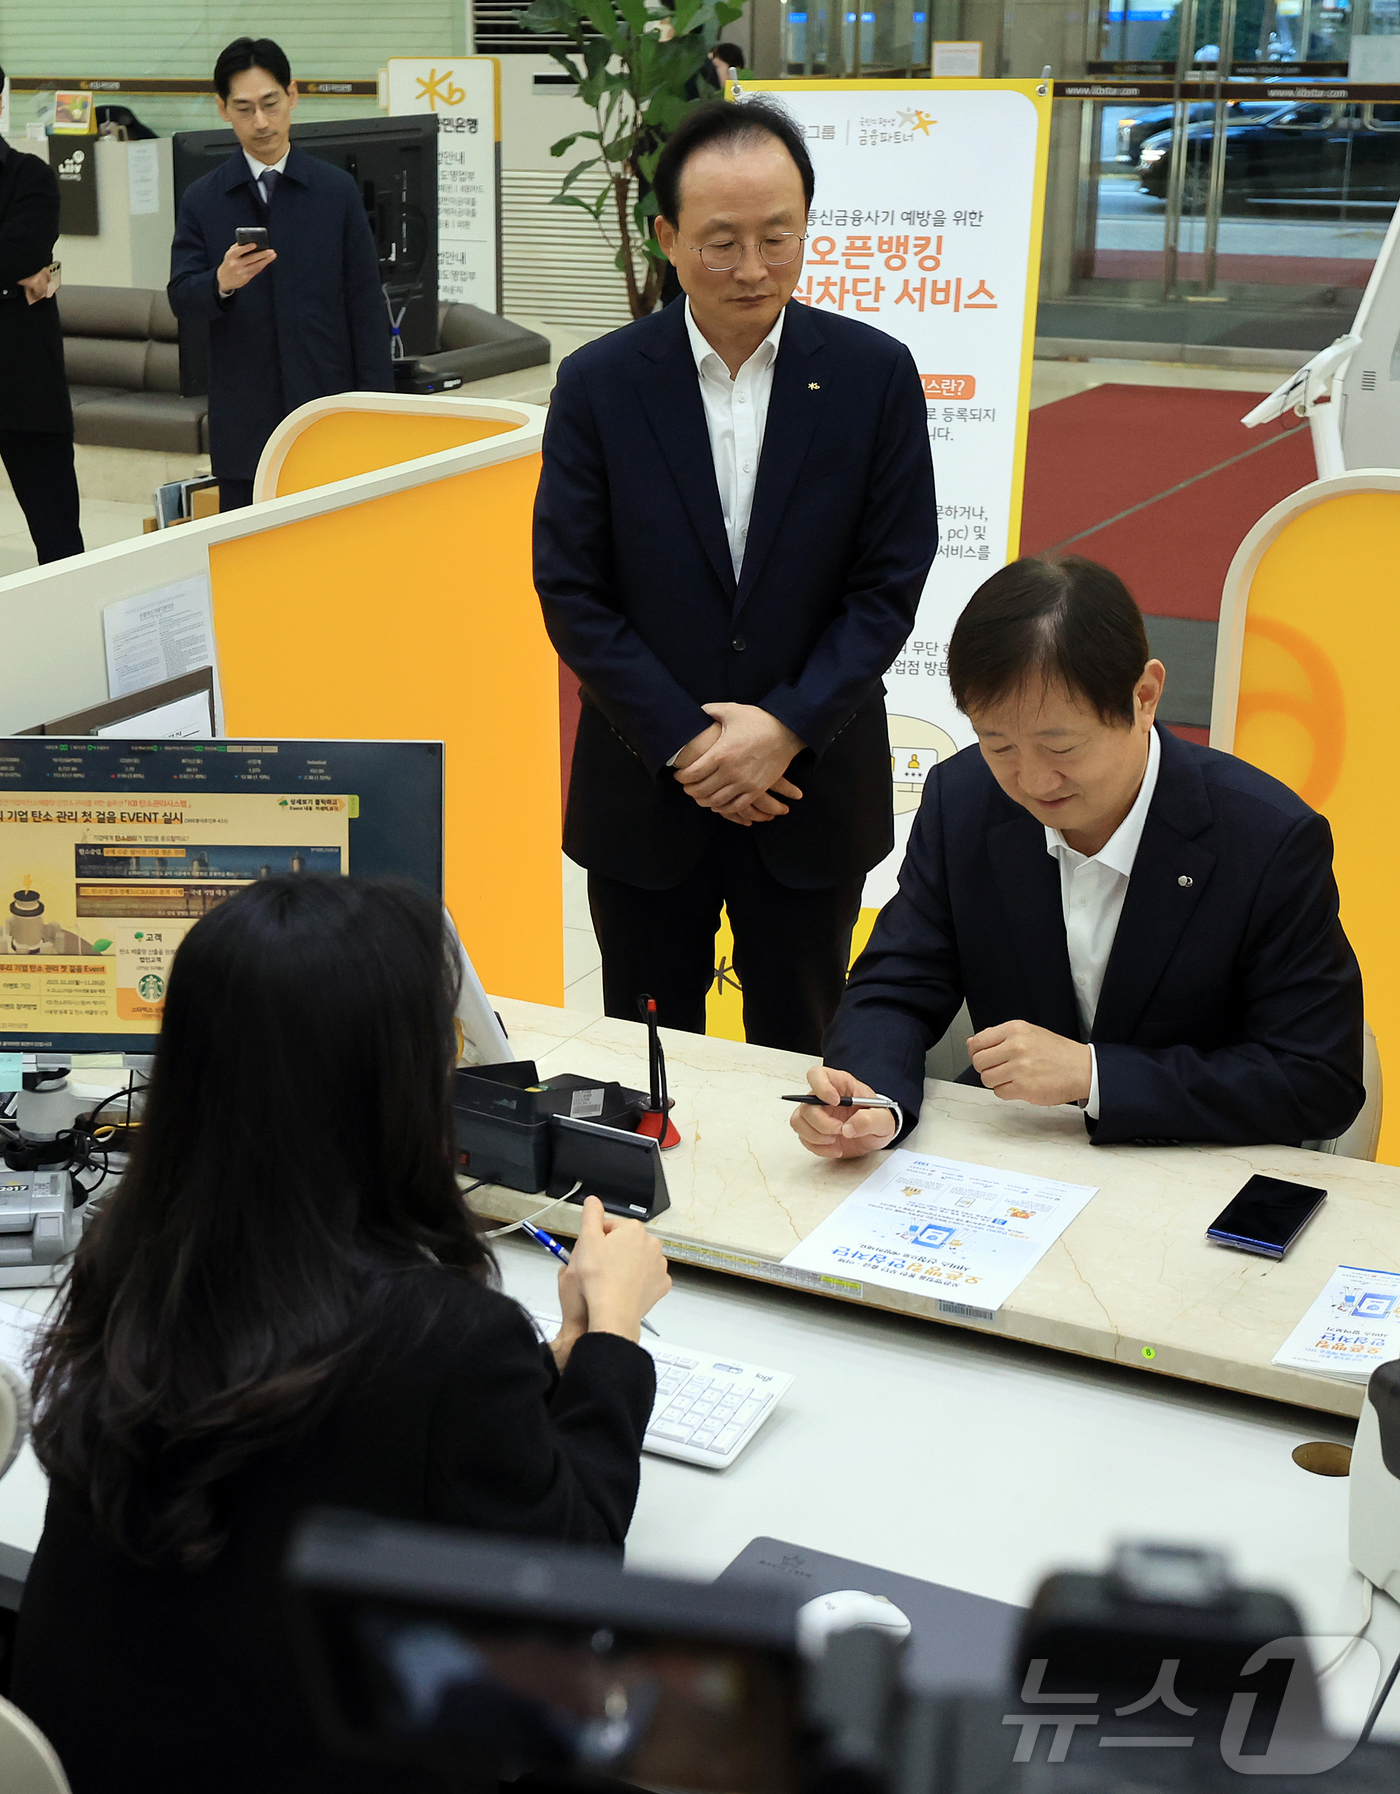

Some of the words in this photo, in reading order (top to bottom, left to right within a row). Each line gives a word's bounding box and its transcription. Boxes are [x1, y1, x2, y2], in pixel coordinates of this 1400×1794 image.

[859, 129, 914, 146] 금융파트너
[900, 210, 947, 227] 예방을
[952, 210, 984, 227] 위한
[806, 235, 943, 271] 오픈뱅킹
[894, 277, 998, 313] 서비스
[942, 408, 996, 422] 등록되지
[973, 525, 986, 541] 및
[937, 544, 991, 560] 서비스를
[912, 641, 939, 657] 무단
[7, 811, 28, 823] 기업
[31, 811, 53, 822] 탄소
[56, 811, 77, 822] 관리
[81, 811, 92, 823] 첫
[96, 811, 117, 824] 걸음
[120, 812, 159, 823] EVENT
[162, 812, 183, 824] 실시
[145, 933, 163, 942] 고객
[14, 964, 28, 972] 기업
[84, 965, 105, 973] Event
[1320, 1332, 1386, 1347] 안심차단
[1315, 1340, 1383, 1355] 오픈뱅킹
[755, 1372, 774, 1383] logi
